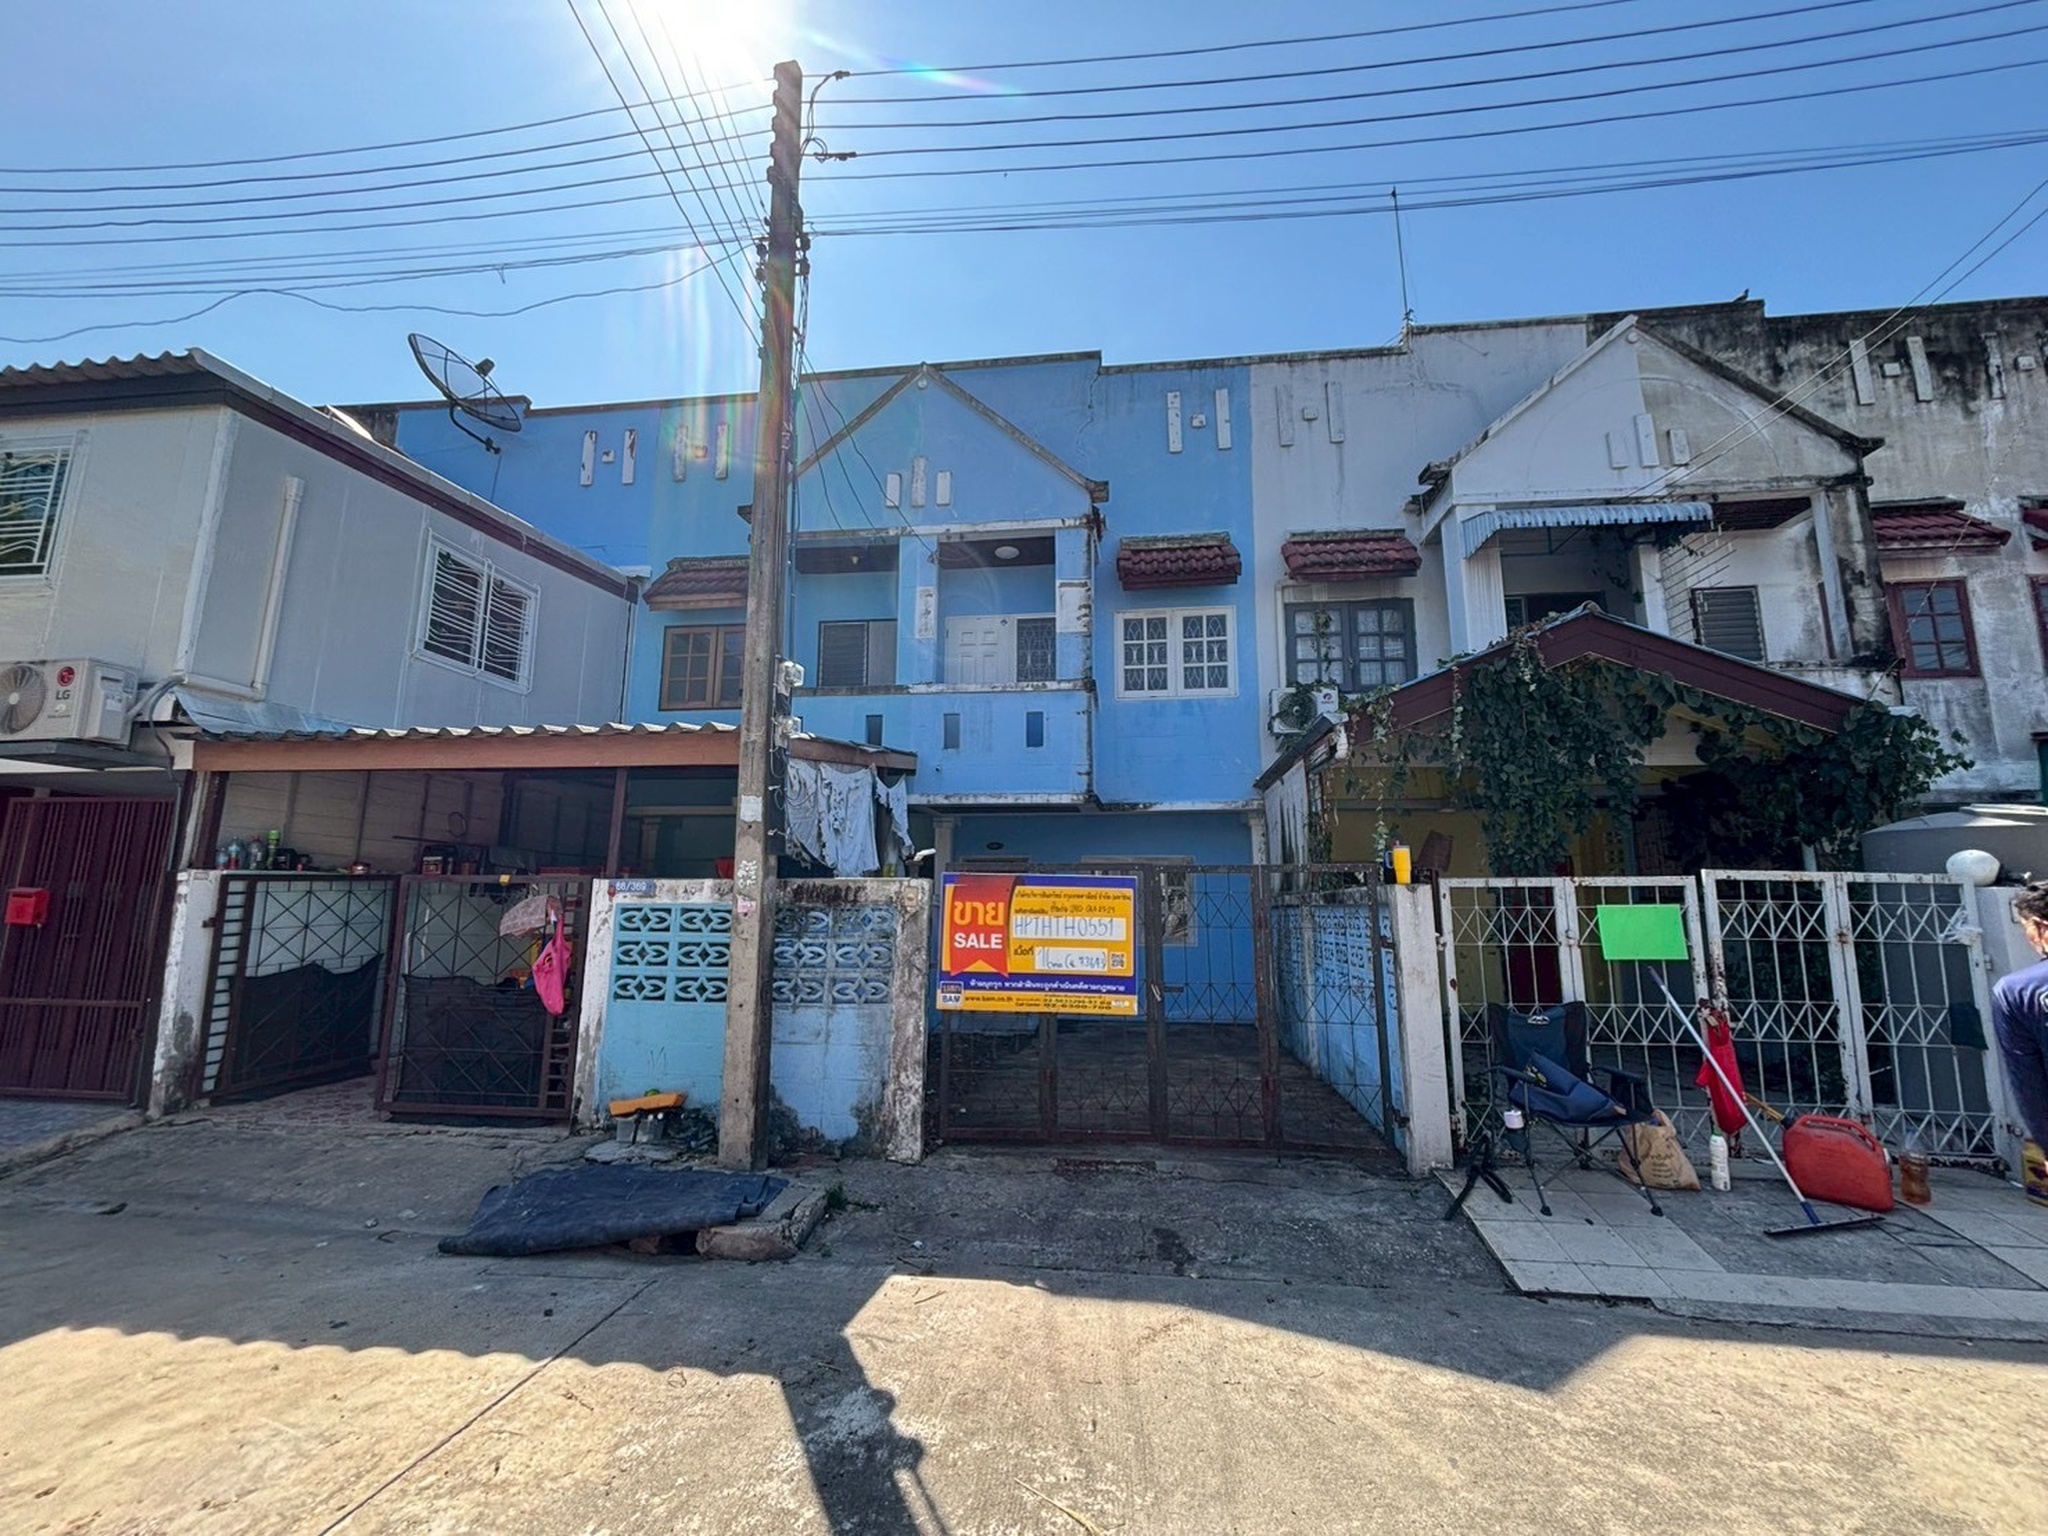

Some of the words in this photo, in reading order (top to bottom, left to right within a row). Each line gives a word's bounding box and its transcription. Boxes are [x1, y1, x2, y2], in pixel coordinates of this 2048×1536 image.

[56, 690, 70, 700] LG
[954, 901, 1005, 926] ขาย
[954, 933, 1003, 949] SALE
[942, 994, 961, 1003] BAM
